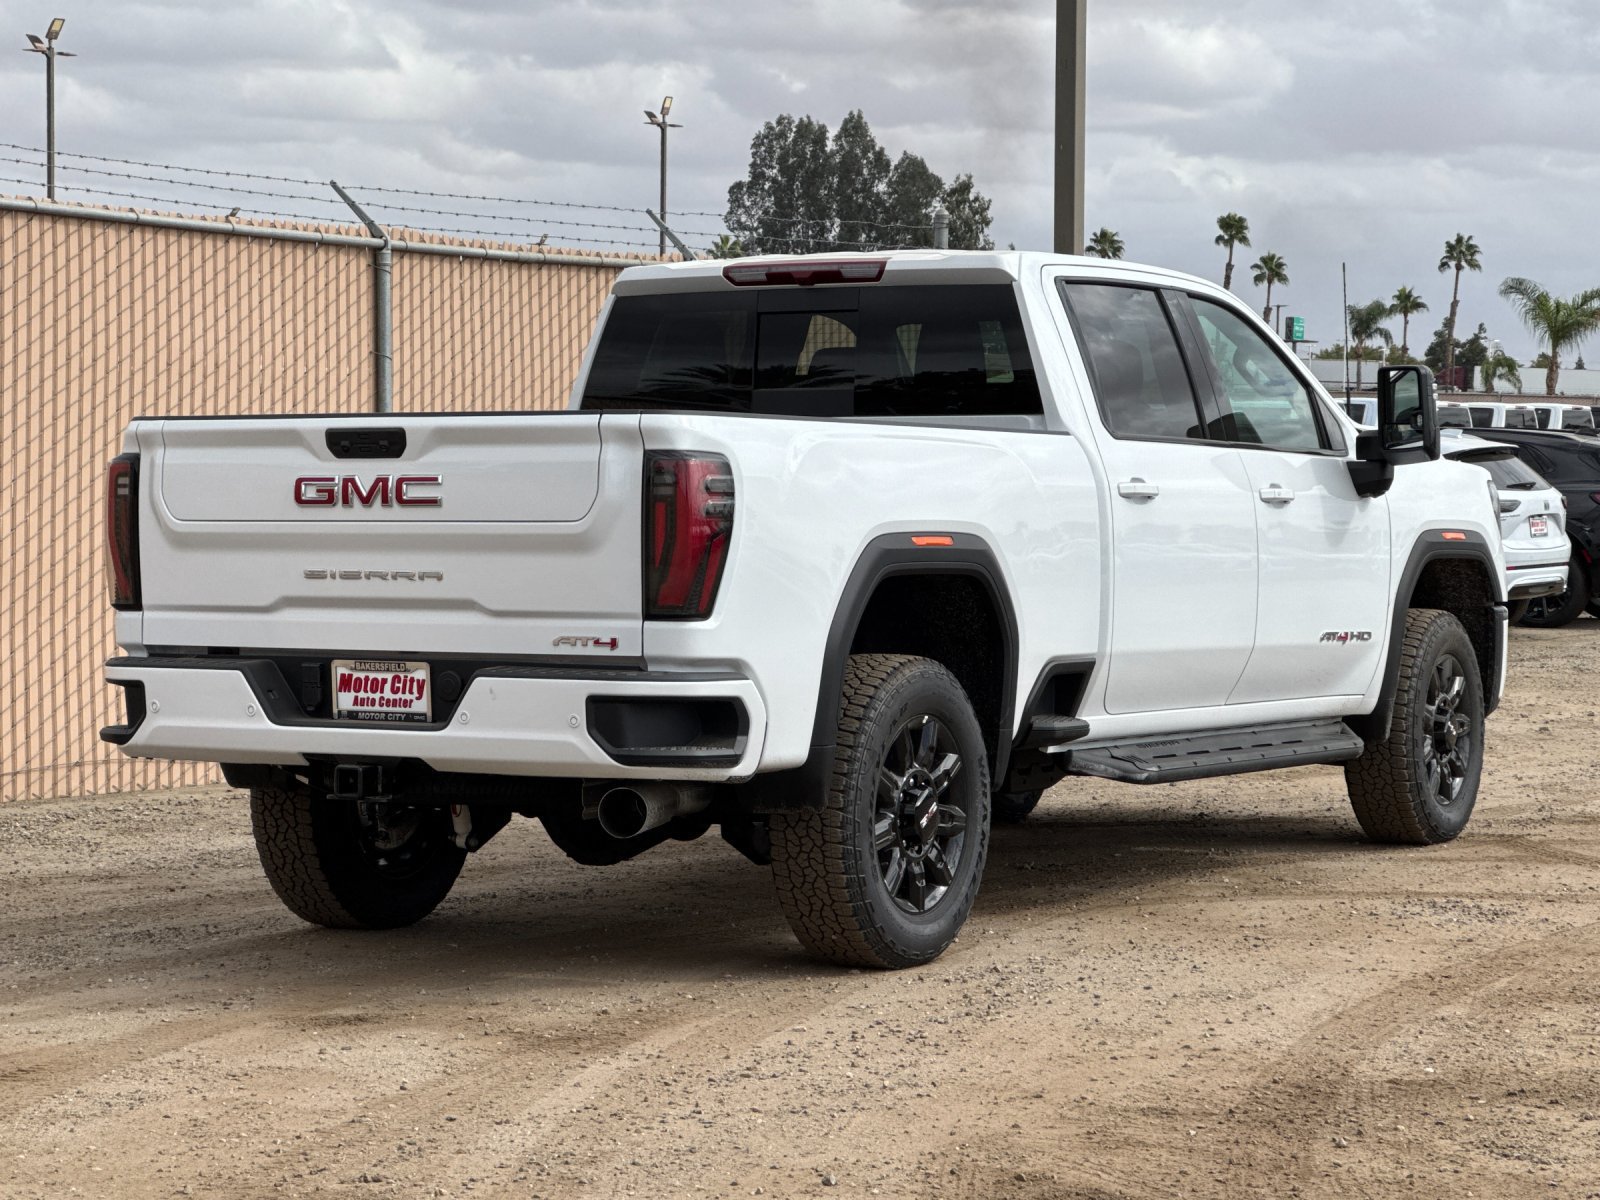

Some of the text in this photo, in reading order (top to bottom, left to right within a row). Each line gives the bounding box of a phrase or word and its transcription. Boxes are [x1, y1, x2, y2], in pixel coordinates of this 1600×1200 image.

[294, 474, 443, 507] GMC
[304, 569, 443, 581] SIERRA
[553, 635, 619, 651] AT4
[355, 662, 406, 672] BAKERSFIELD
[337, 673, 426, 701] Motor City
[352, 695, 414, 708] Auto Center
[358, 712, 386, 721] MOTOR
[387, 713, 406, 721] CITY
